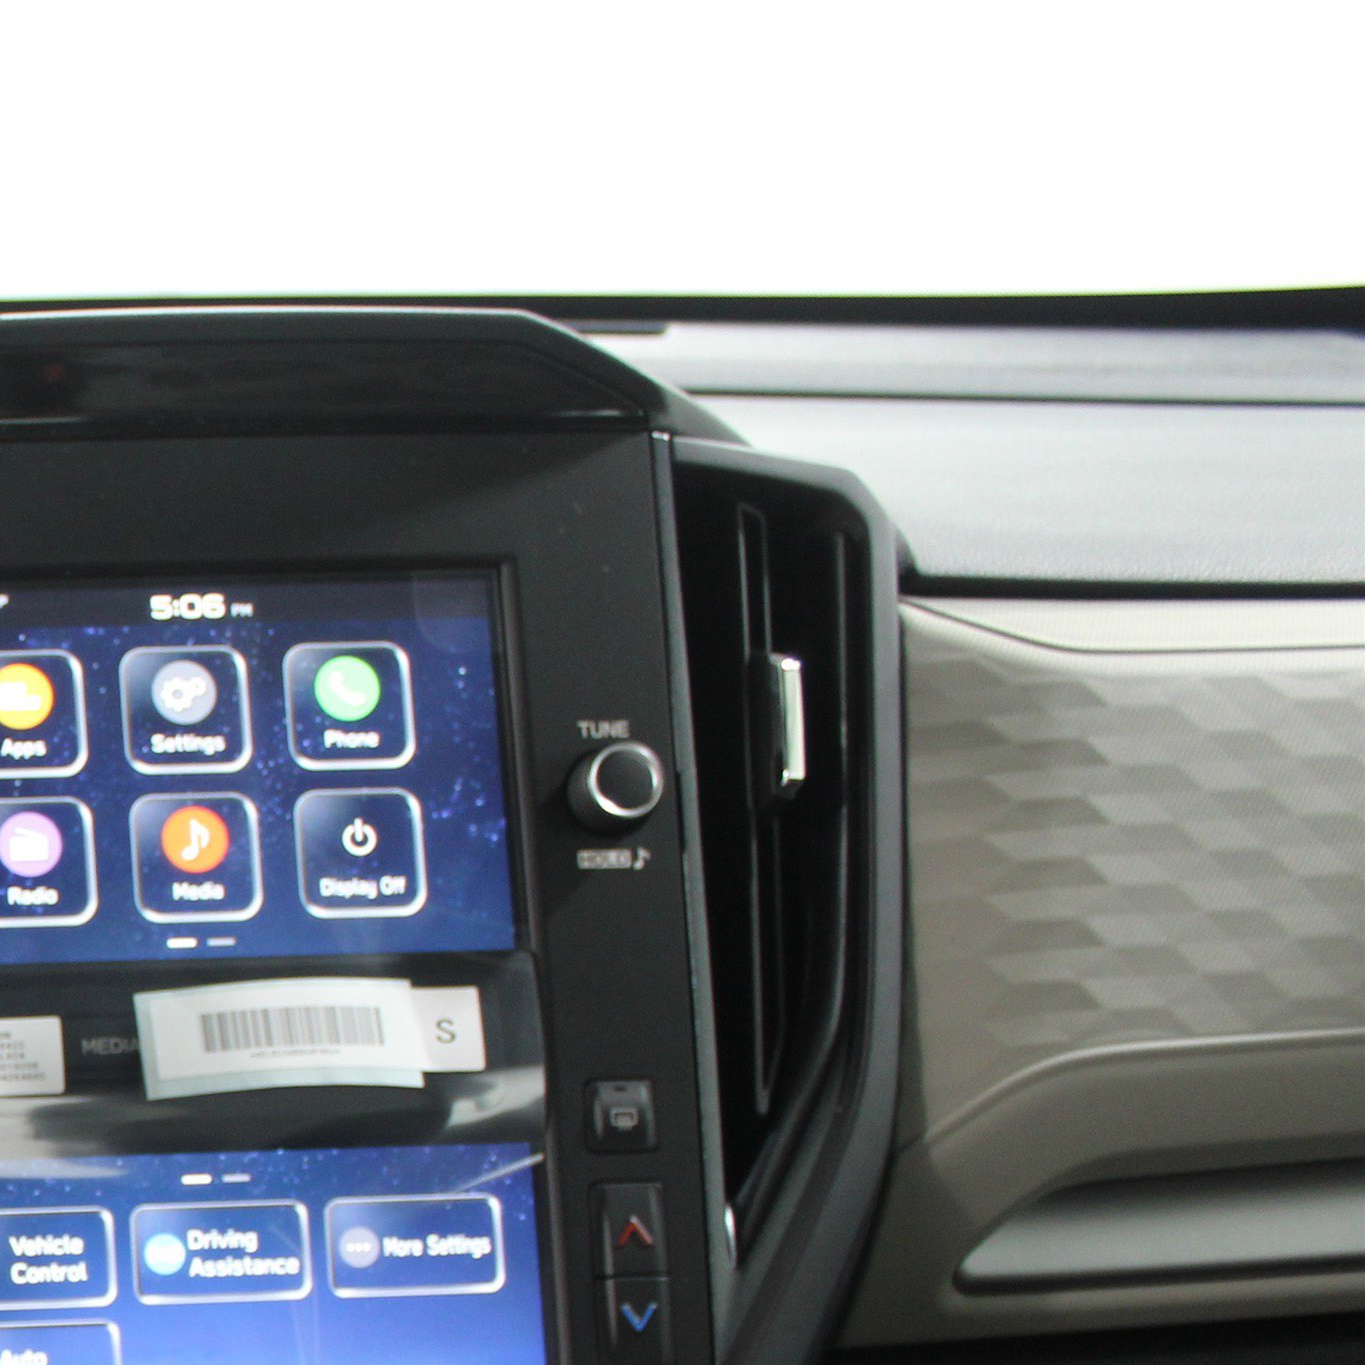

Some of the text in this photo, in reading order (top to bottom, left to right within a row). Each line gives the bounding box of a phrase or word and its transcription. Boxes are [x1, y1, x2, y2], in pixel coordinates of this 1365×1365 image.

[149, 592, 226, 621] 5:06
[324, 729, 379, 749] Phone
[576, 720, 630, 739] TUNE
[1, 737, 46, 759] Apps
[150, 732, 225, 756] Settings
[7, 885, 58, 905] Radio
[172, 880, 225, 901] Media
[319, 875, 407, 900] Display Off
[435, 1019, 456, 1044] S
[9, 1234, 84, 1258] Vehicle
[187, 1228, 258, 1253] Driving
[383, 1234, 492, 1260] More Settings
[10, 1260, 88, 1285] Control
[187, 1253, 300, 1279] Assistance
